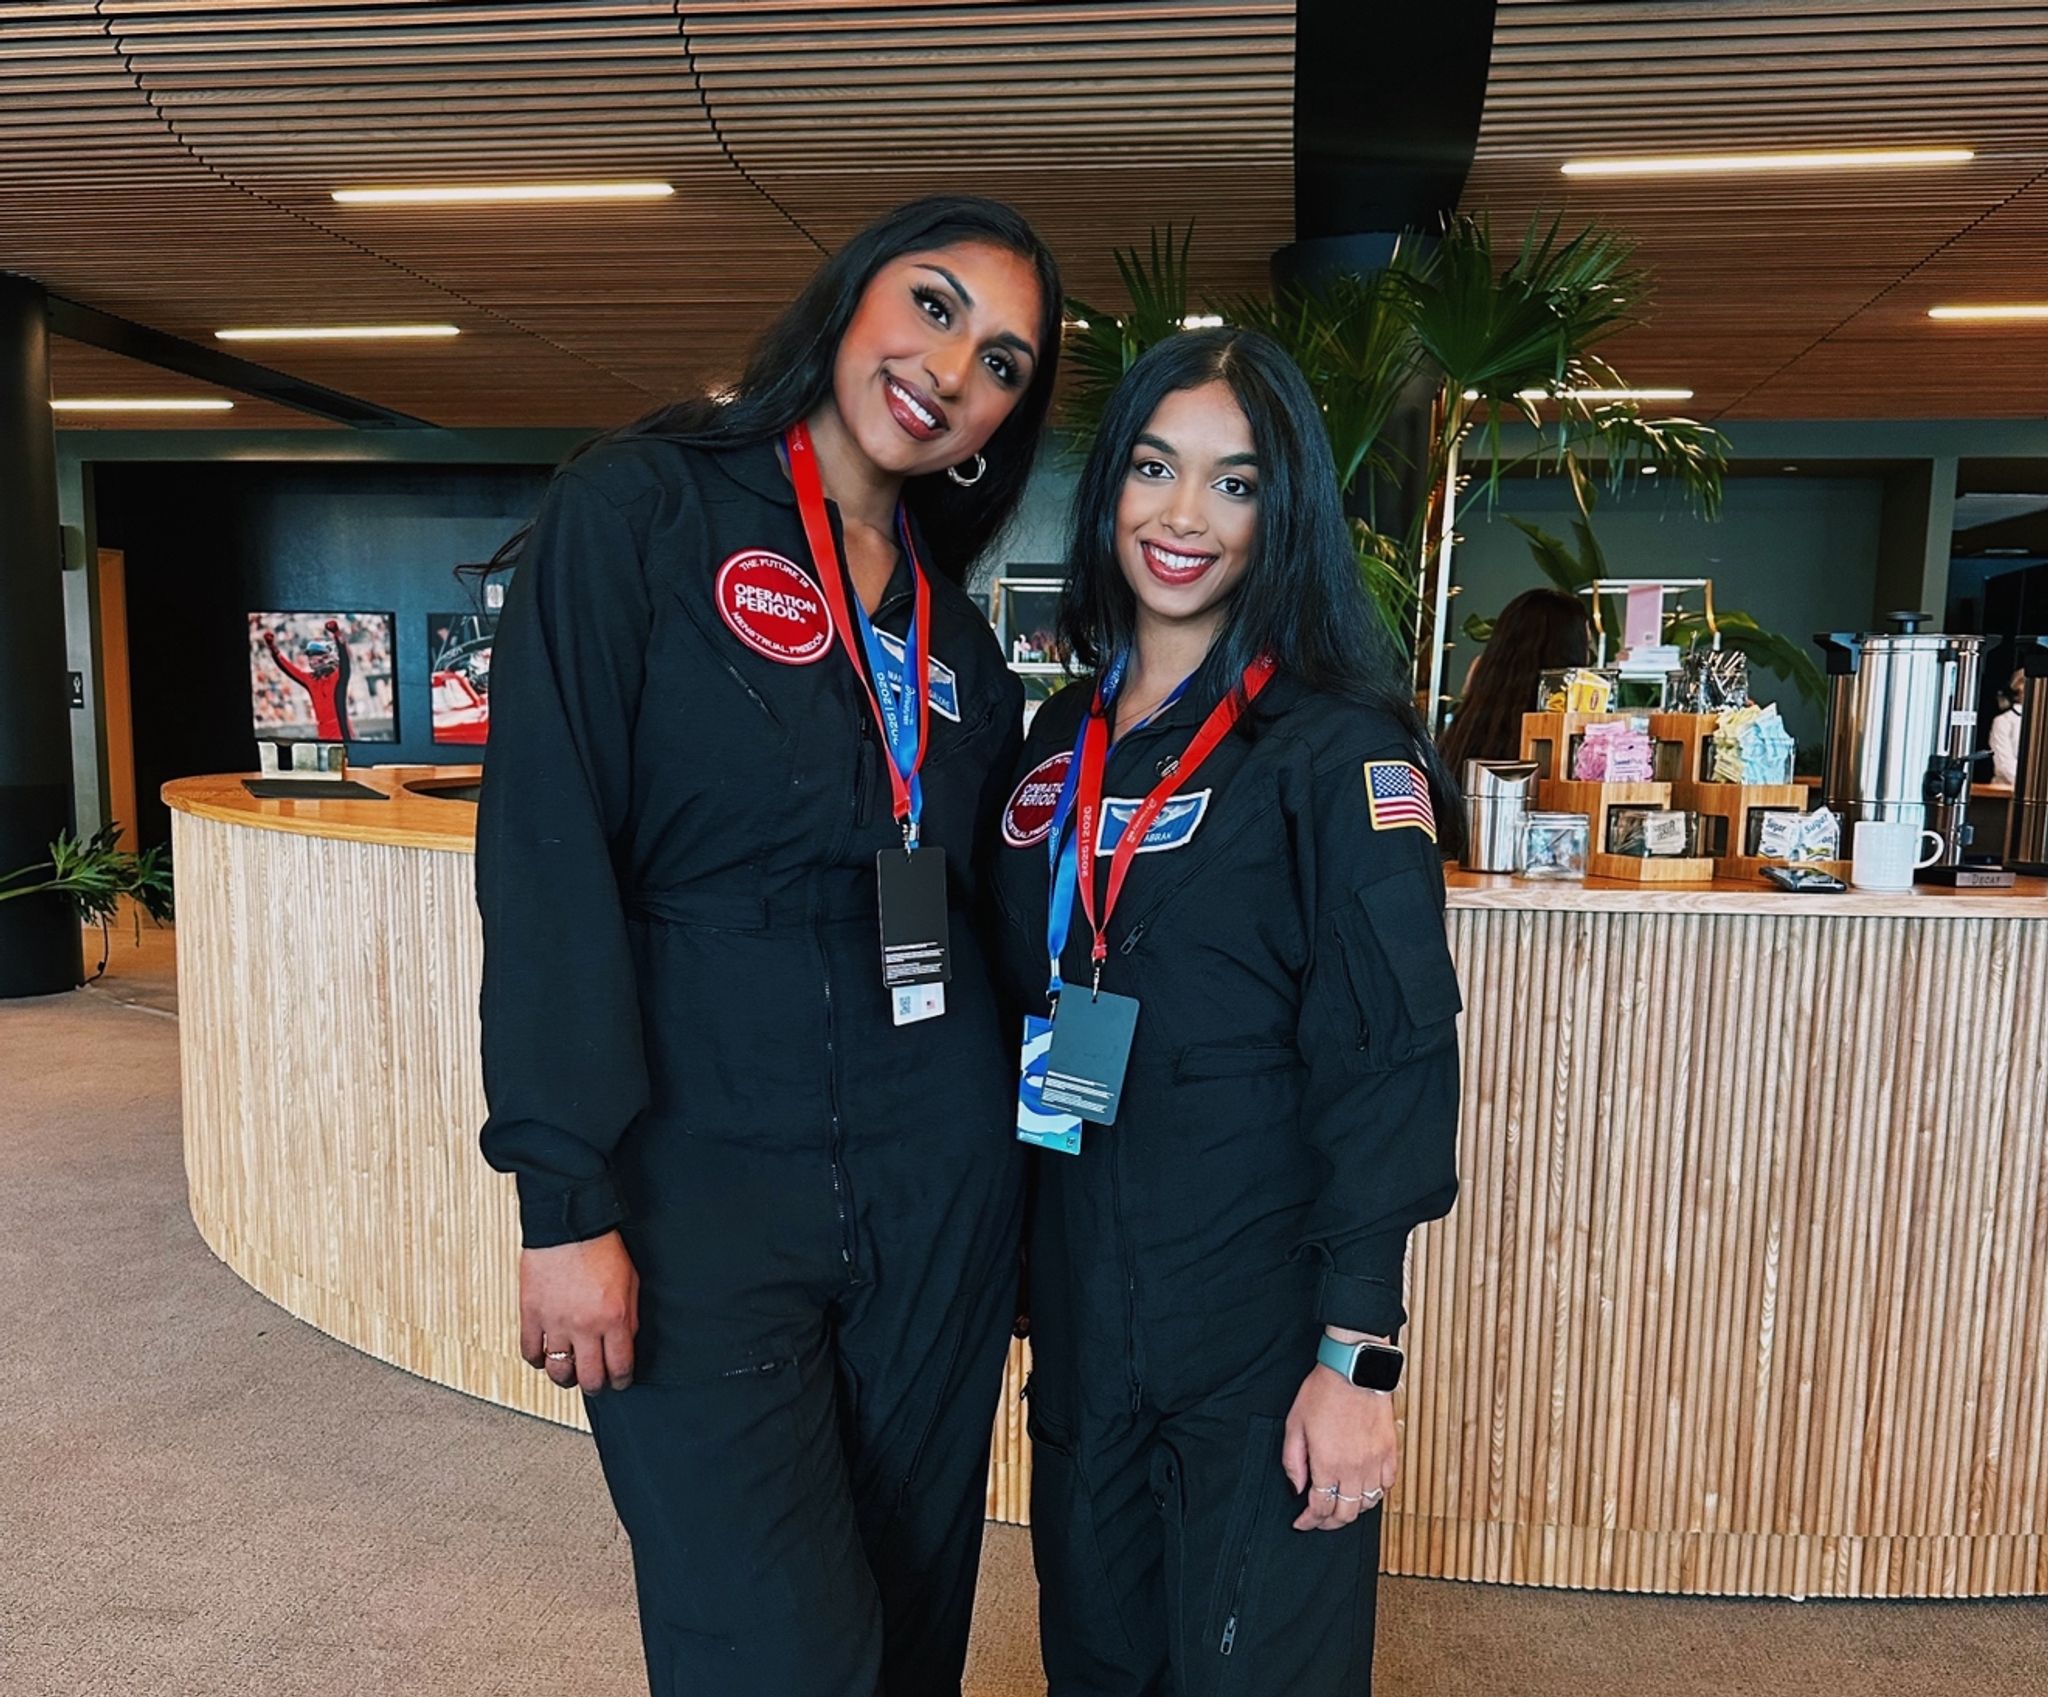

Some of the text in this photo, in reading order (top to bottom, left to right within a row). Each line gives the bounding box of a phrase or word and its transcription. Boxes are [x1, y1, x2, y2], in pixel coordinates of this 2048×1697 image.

[739, 558, 759, 571] THE
[760, 558, 799, 580] FUTURE
[734, 583, 817, 614] OPERATION
[735, 594, 807, 624] PERIOD.
[1804, 814, 1828, 834] Sugar
